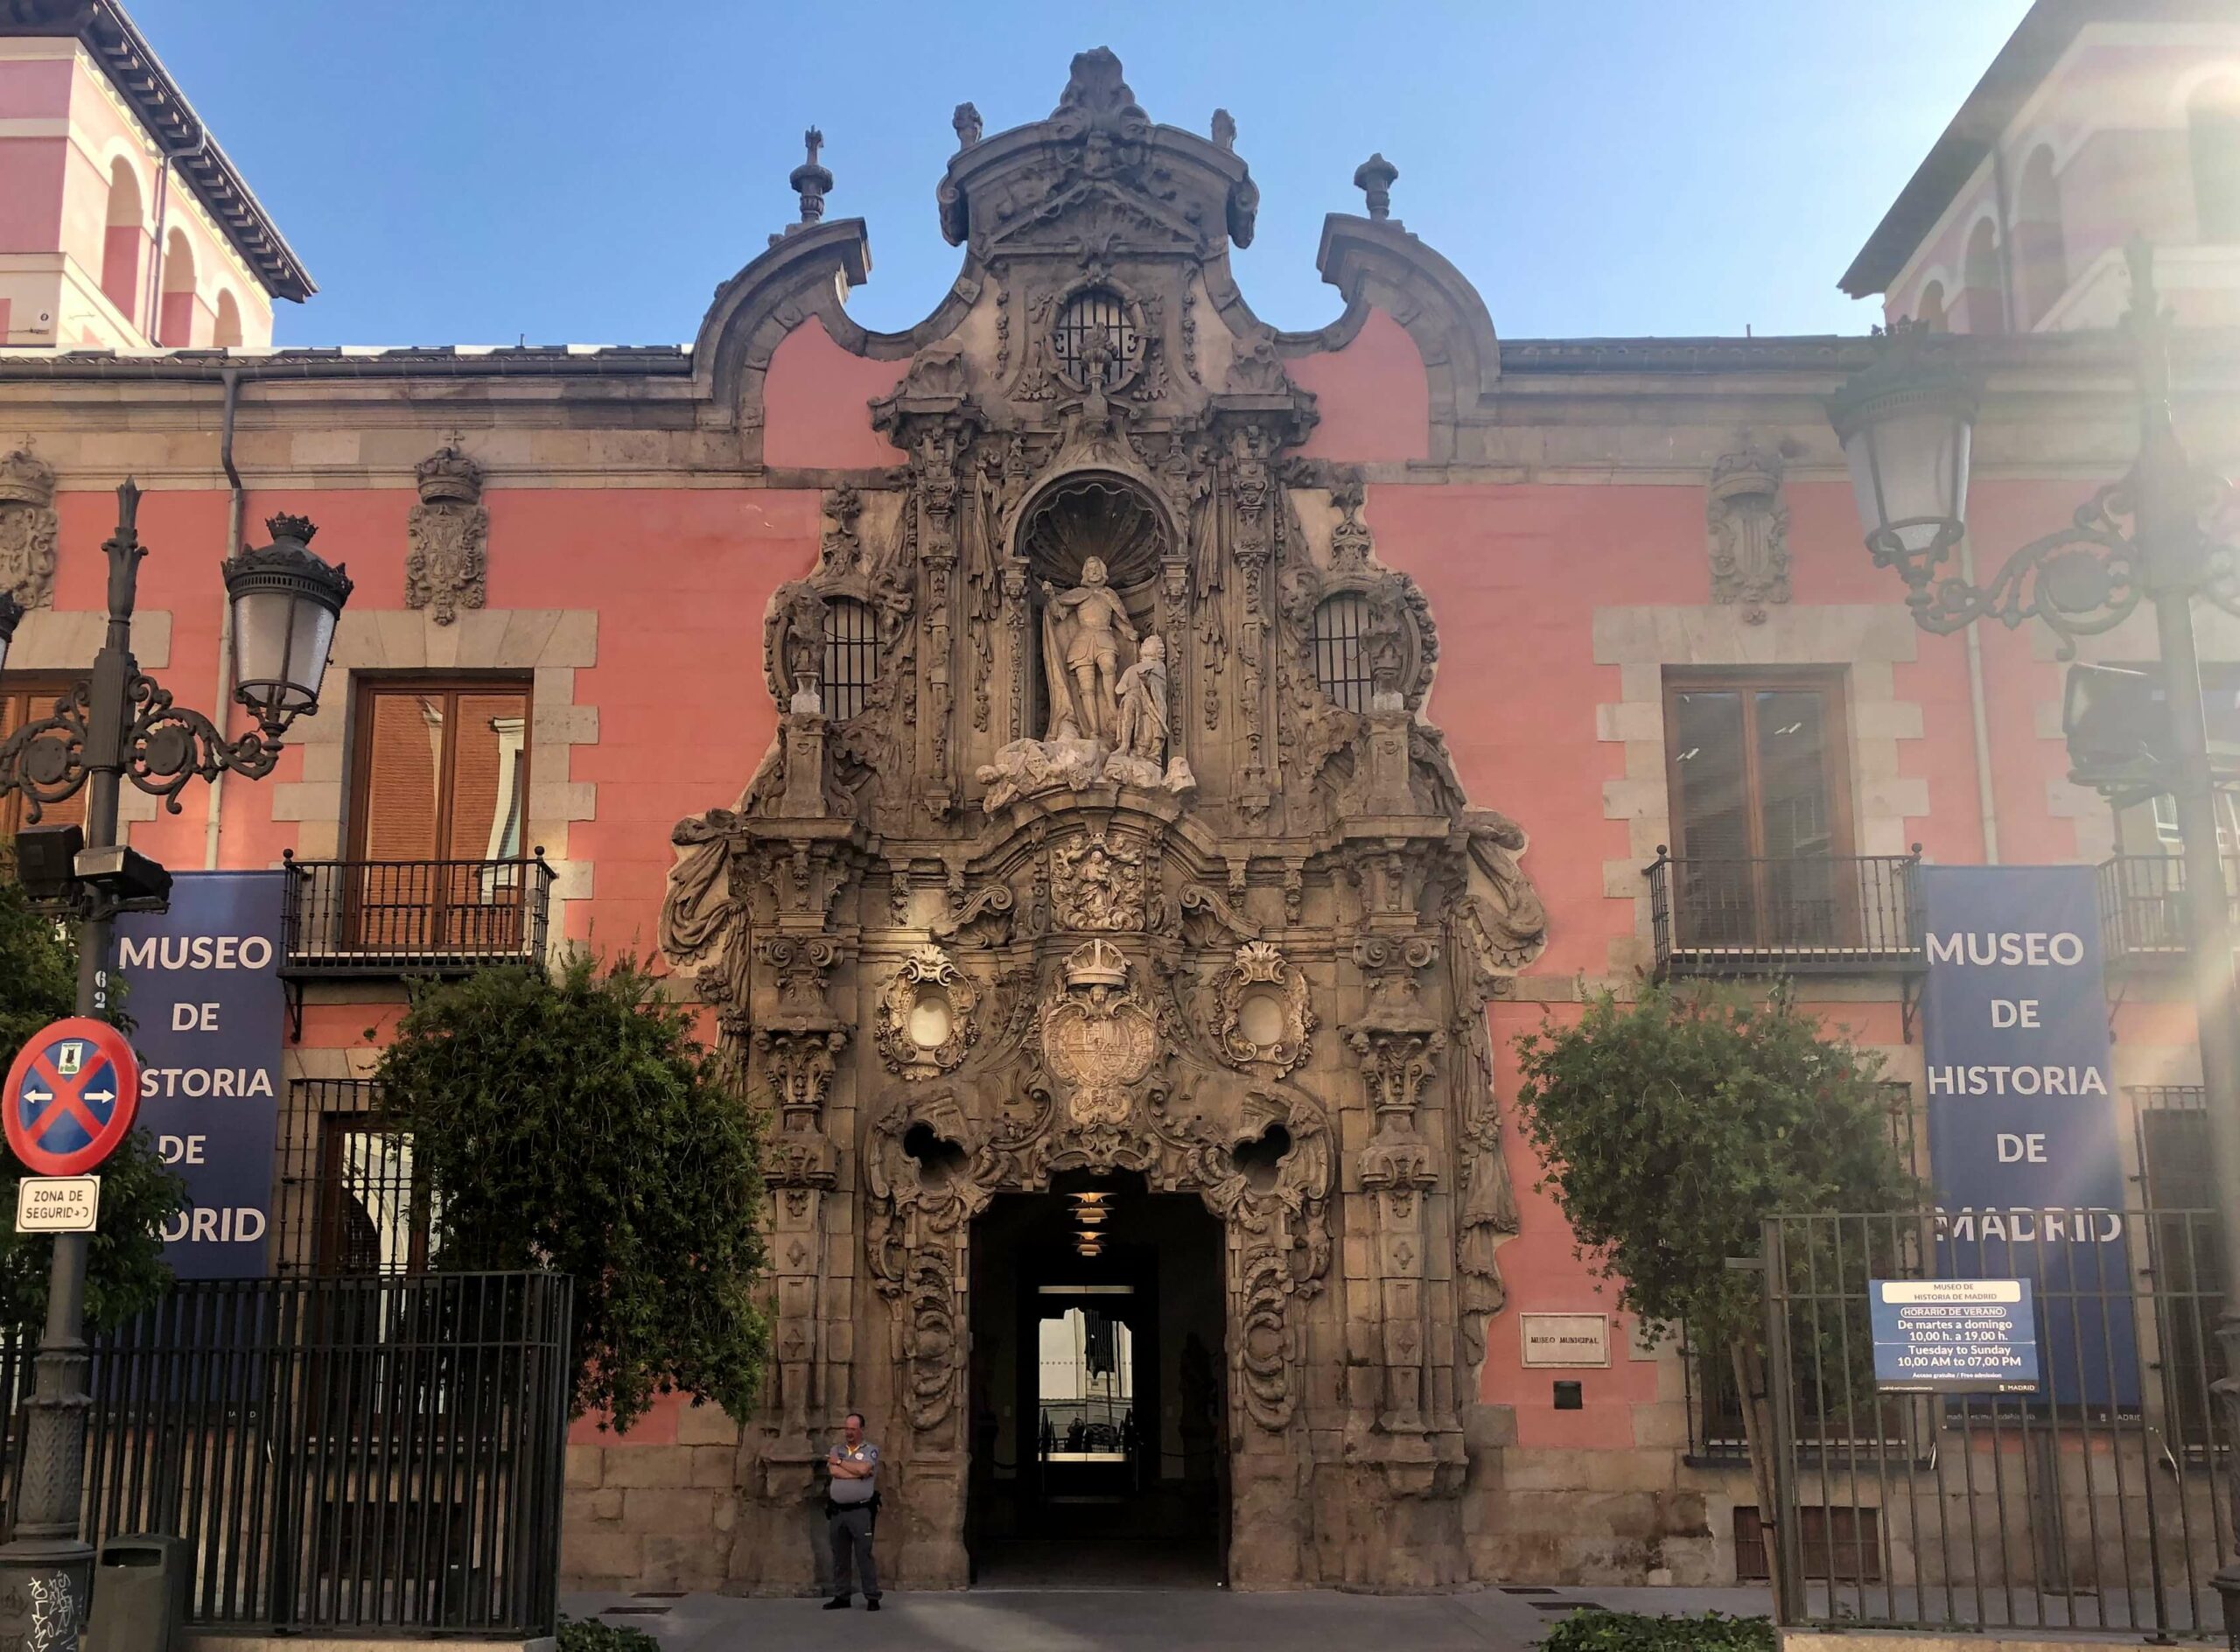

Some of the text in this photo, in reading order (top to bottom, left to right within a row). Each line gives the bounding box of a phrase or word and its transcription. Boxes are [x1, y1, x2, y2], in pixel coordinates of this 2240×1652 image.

[119, 936, 273, 970] MUSEO
[1927, 932, 2085, 966] MUSEO
[172, 1003, 220, 1031] DE
[1991, 999, 2040, 1028] DE
[141, 1068, 274, 1097] STORIA
[1928, 1065, 2108, 1096] HISTORIA
[158, 1135, 206, 1165] DE
[1996, 1133, 2048, 1163] DE
[34, 1190, 83, 1201] ZONA DE
[150, 1208, 266, 1242] DRID
[1898, 1320, 1914, 1329] De
[1916, 1320, 1953, 1329] martes
[1964, 1320, 2012, 1330] domingo
[1942, 1332, 1952, 1340] h.
[1998, 1331, 2008, 1340] h.
[1908, 1345, 2011, 1356] Tuesday to Sunday
[1931, 1357, 1950, 1366] AM
[1954, 1357, 1965, 1366] to
[2002, 1356, 2021, 1366] PM
